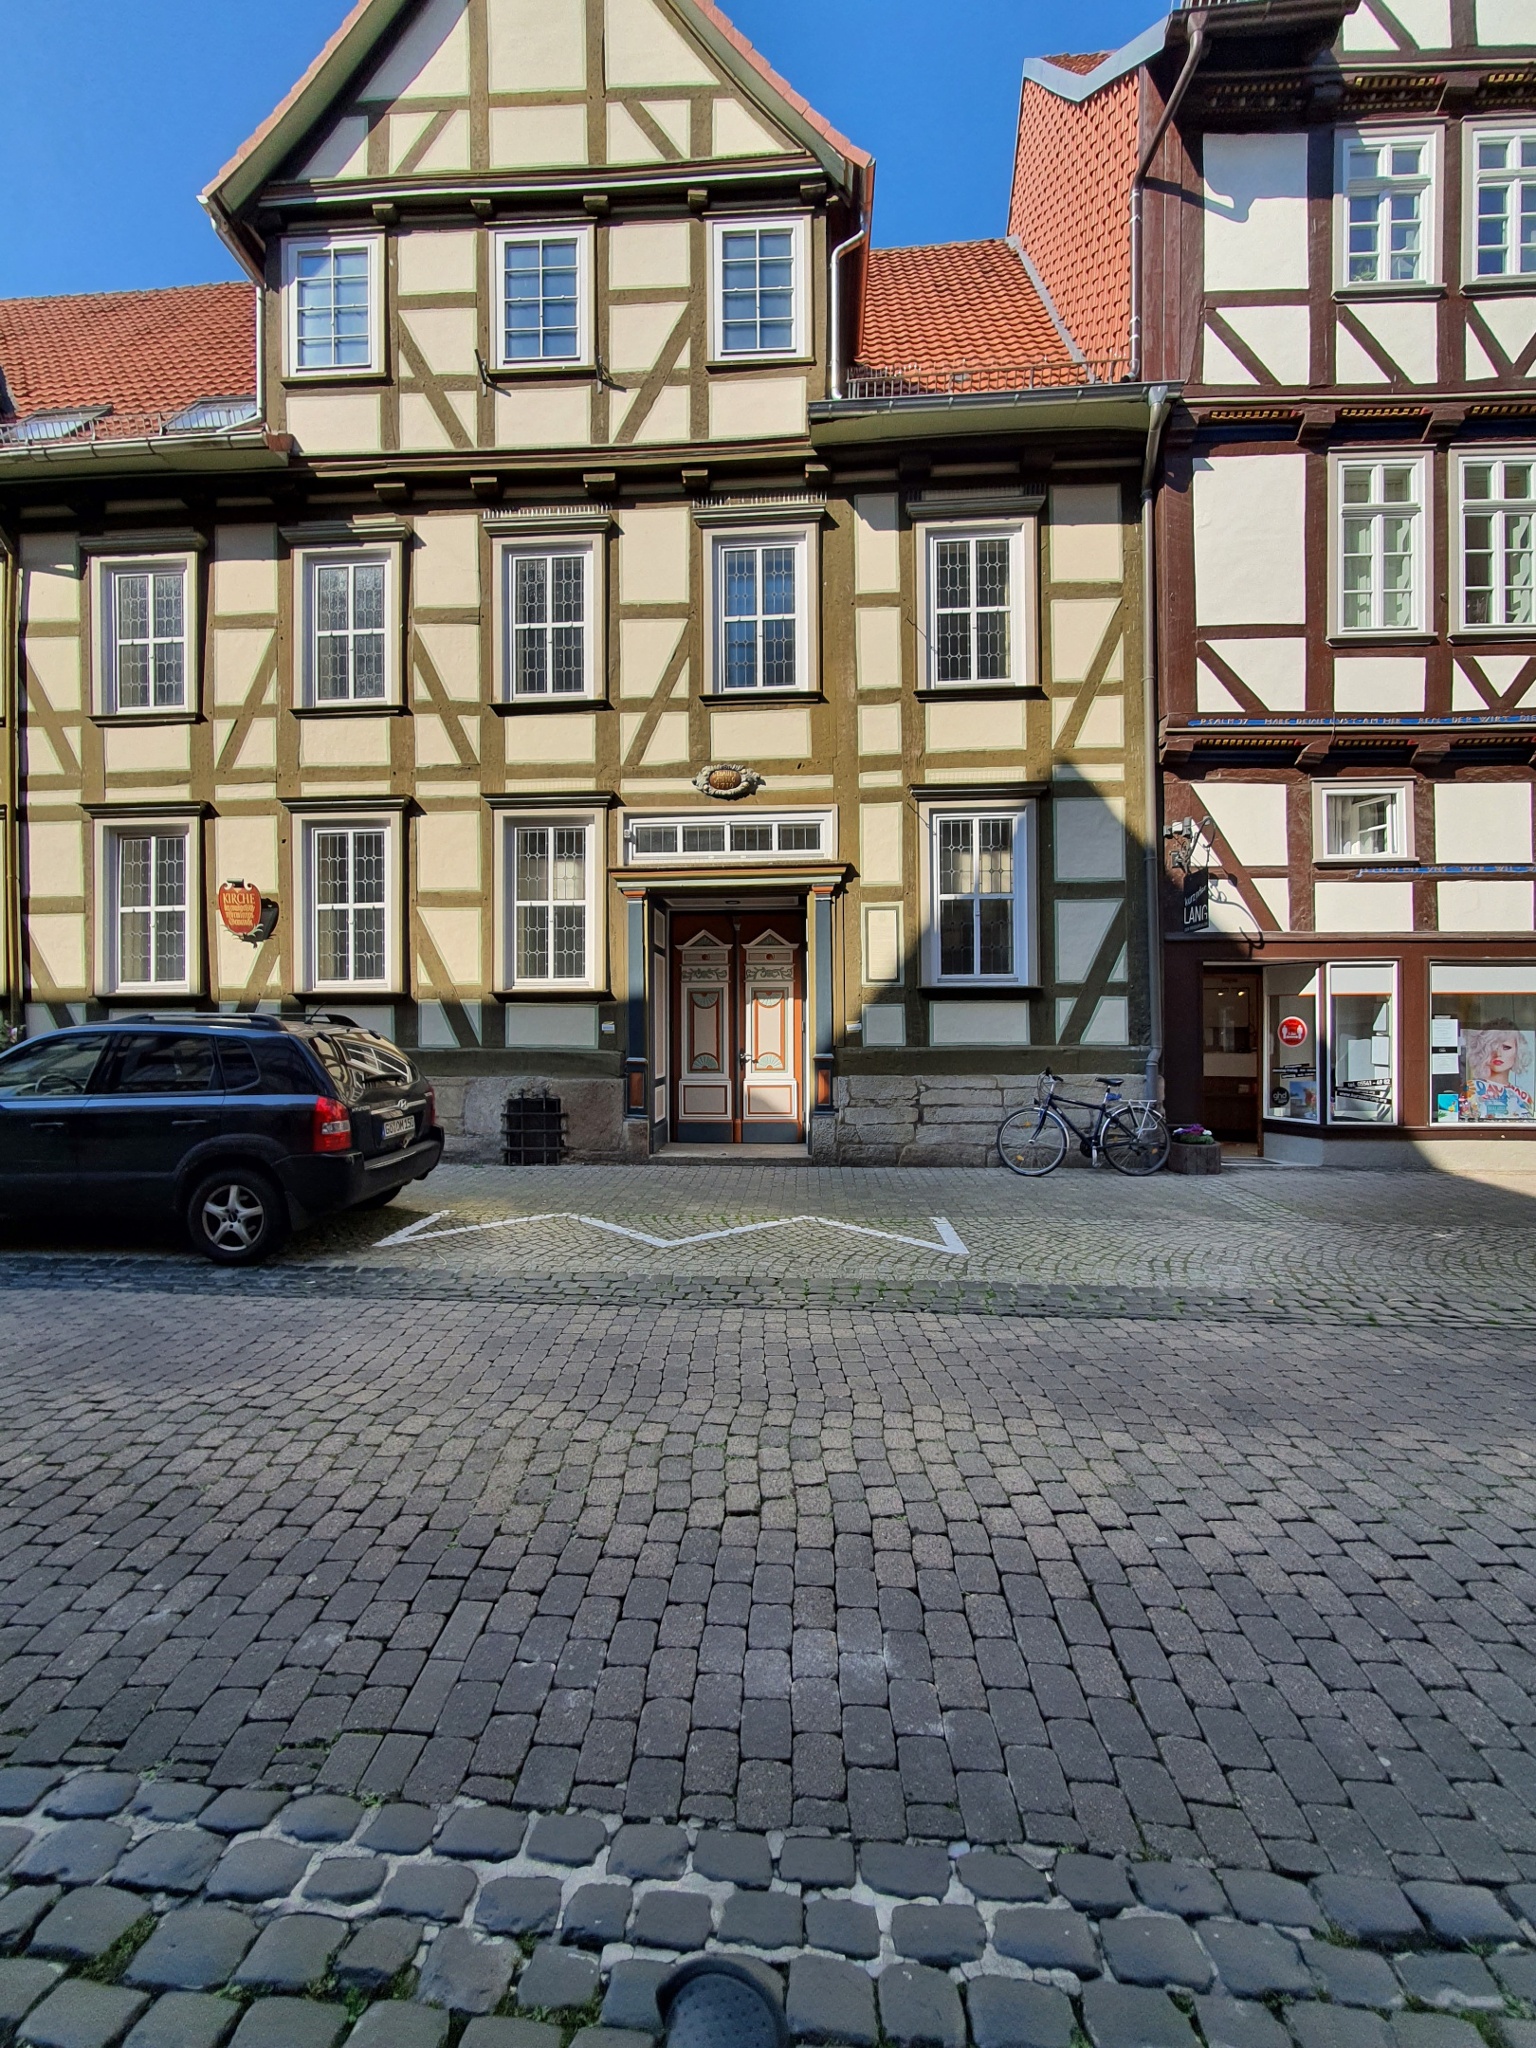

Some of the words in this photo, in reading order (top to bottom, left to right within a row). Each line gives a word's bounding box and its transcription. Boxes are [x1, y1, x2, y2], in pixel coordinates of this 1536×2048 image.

[222, 893, 255, 904] KIRCHE
[1184, 904, 1207, 924] LANG
[1273, 1091, 1288, 1101] ghd
